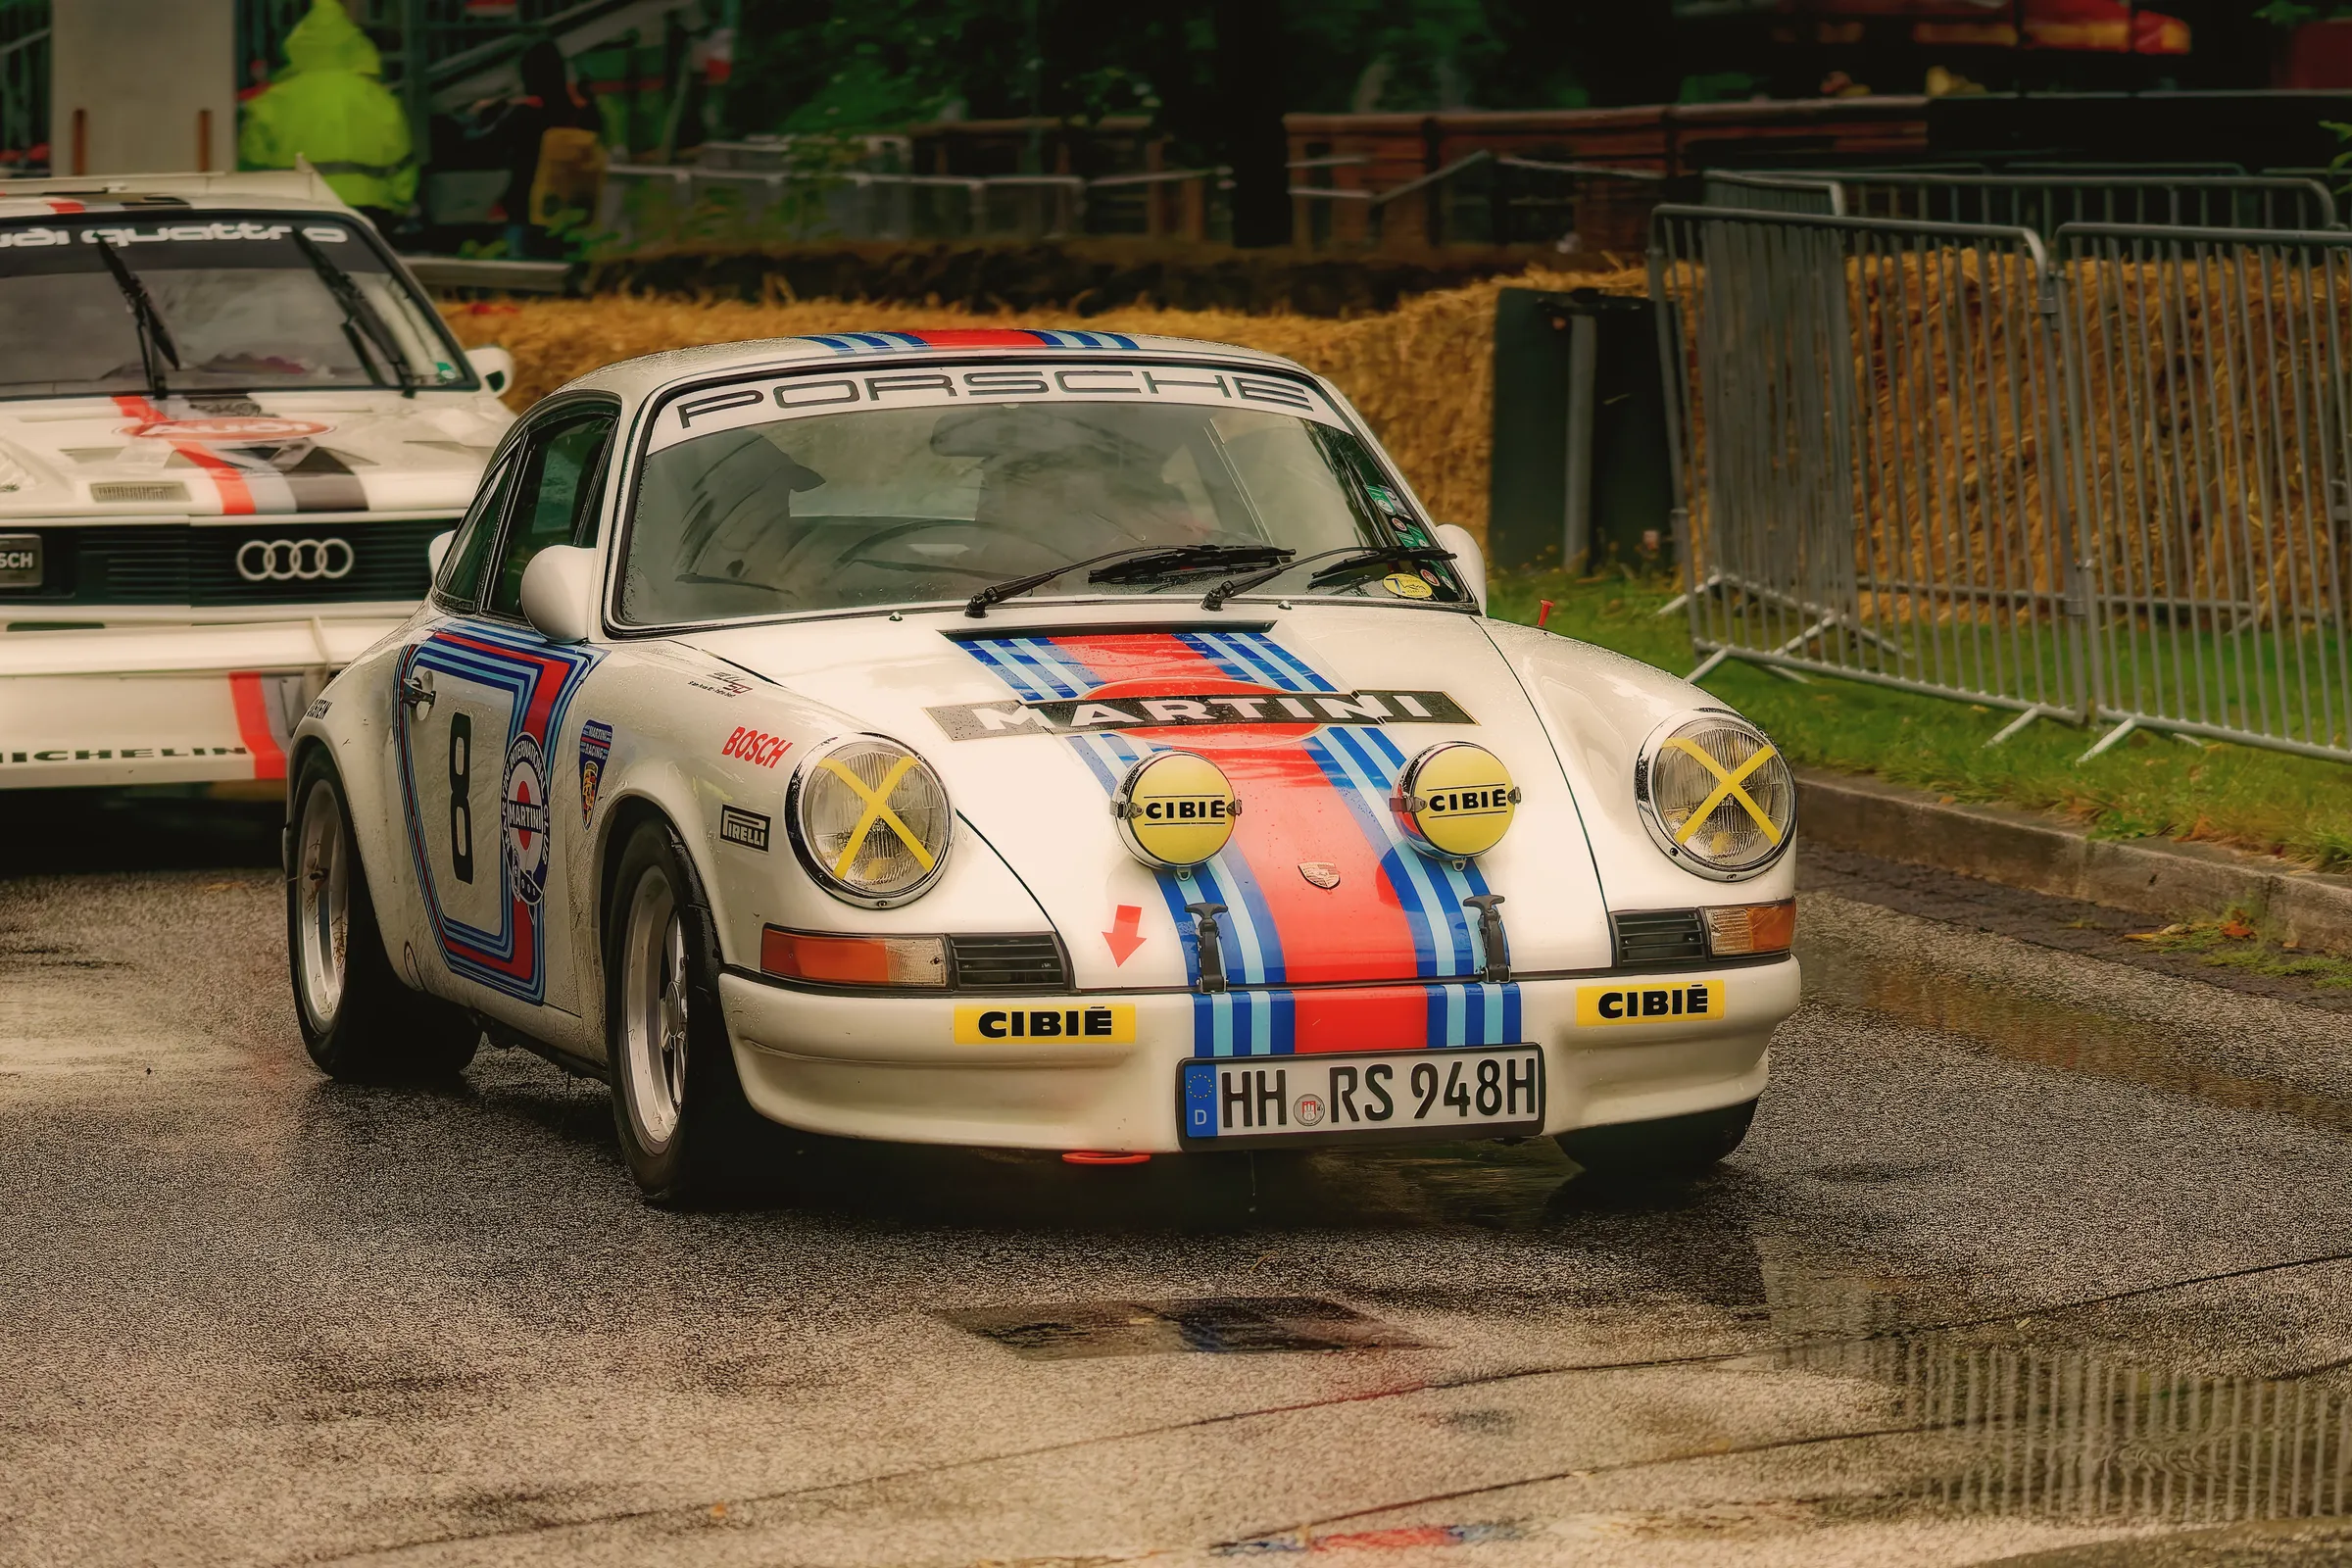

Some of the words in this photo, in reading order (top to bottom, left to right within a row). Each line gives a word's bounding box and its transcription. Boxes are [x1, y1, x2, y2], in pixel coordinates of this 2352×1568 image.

[80, 222, 348, 247] quattro
[678, 370, 1314, 428] PORSCHE
[970, 692, 1434, 732] MARTINI
[0, 748, 247, 763] ICHELIN
[721, 726, 794, 769] BOSCH
[510, 741, 546, 800] INTERNATIONAL
[449, 711, 473, 886] 8
[509, 802, 542, 830] MARTINI
[722, 809, 766, 847] PIRELLI
[1221, 1069, 1287, 1128] HH
[1329, 1063, 1395, 1123] RS
[1410, 1057, 1536, 1119] 948H
[1194, 1109, 1207, 1125] D
